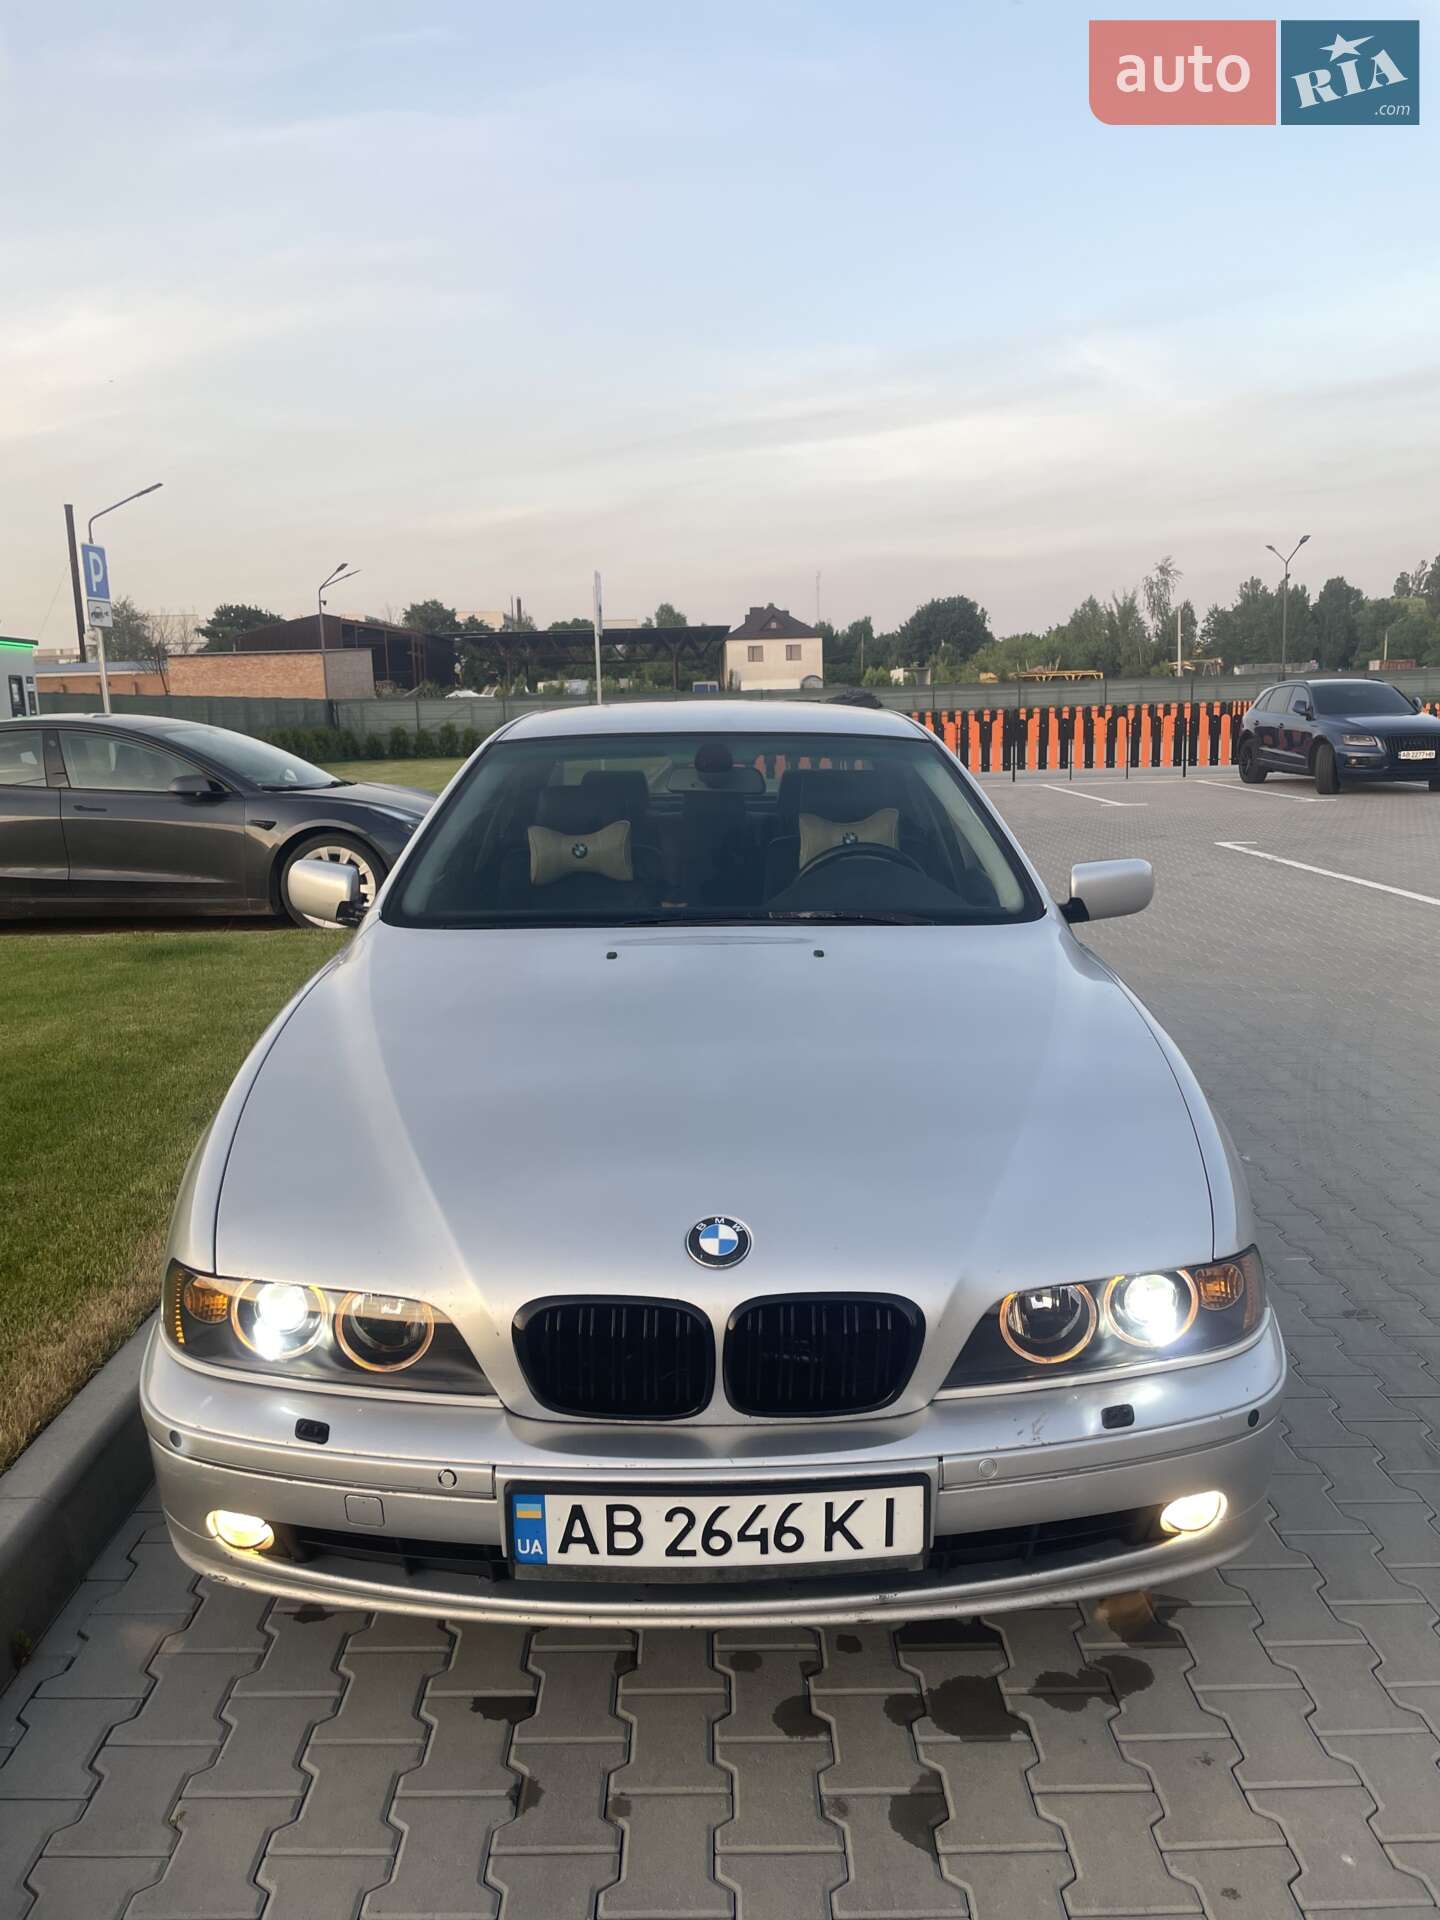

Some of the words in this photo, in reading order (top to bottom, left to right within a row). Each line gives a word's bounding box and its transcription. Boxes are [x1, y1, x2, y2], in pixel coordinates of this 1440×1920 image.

[88, 551, 104, 593] P
[517, 1539, 544, 1555] UA
[557, 1504, 645, 1556] AB
[664, 1502, 806, 1557] 2646
[823, 1497, 896, 1553] KI
